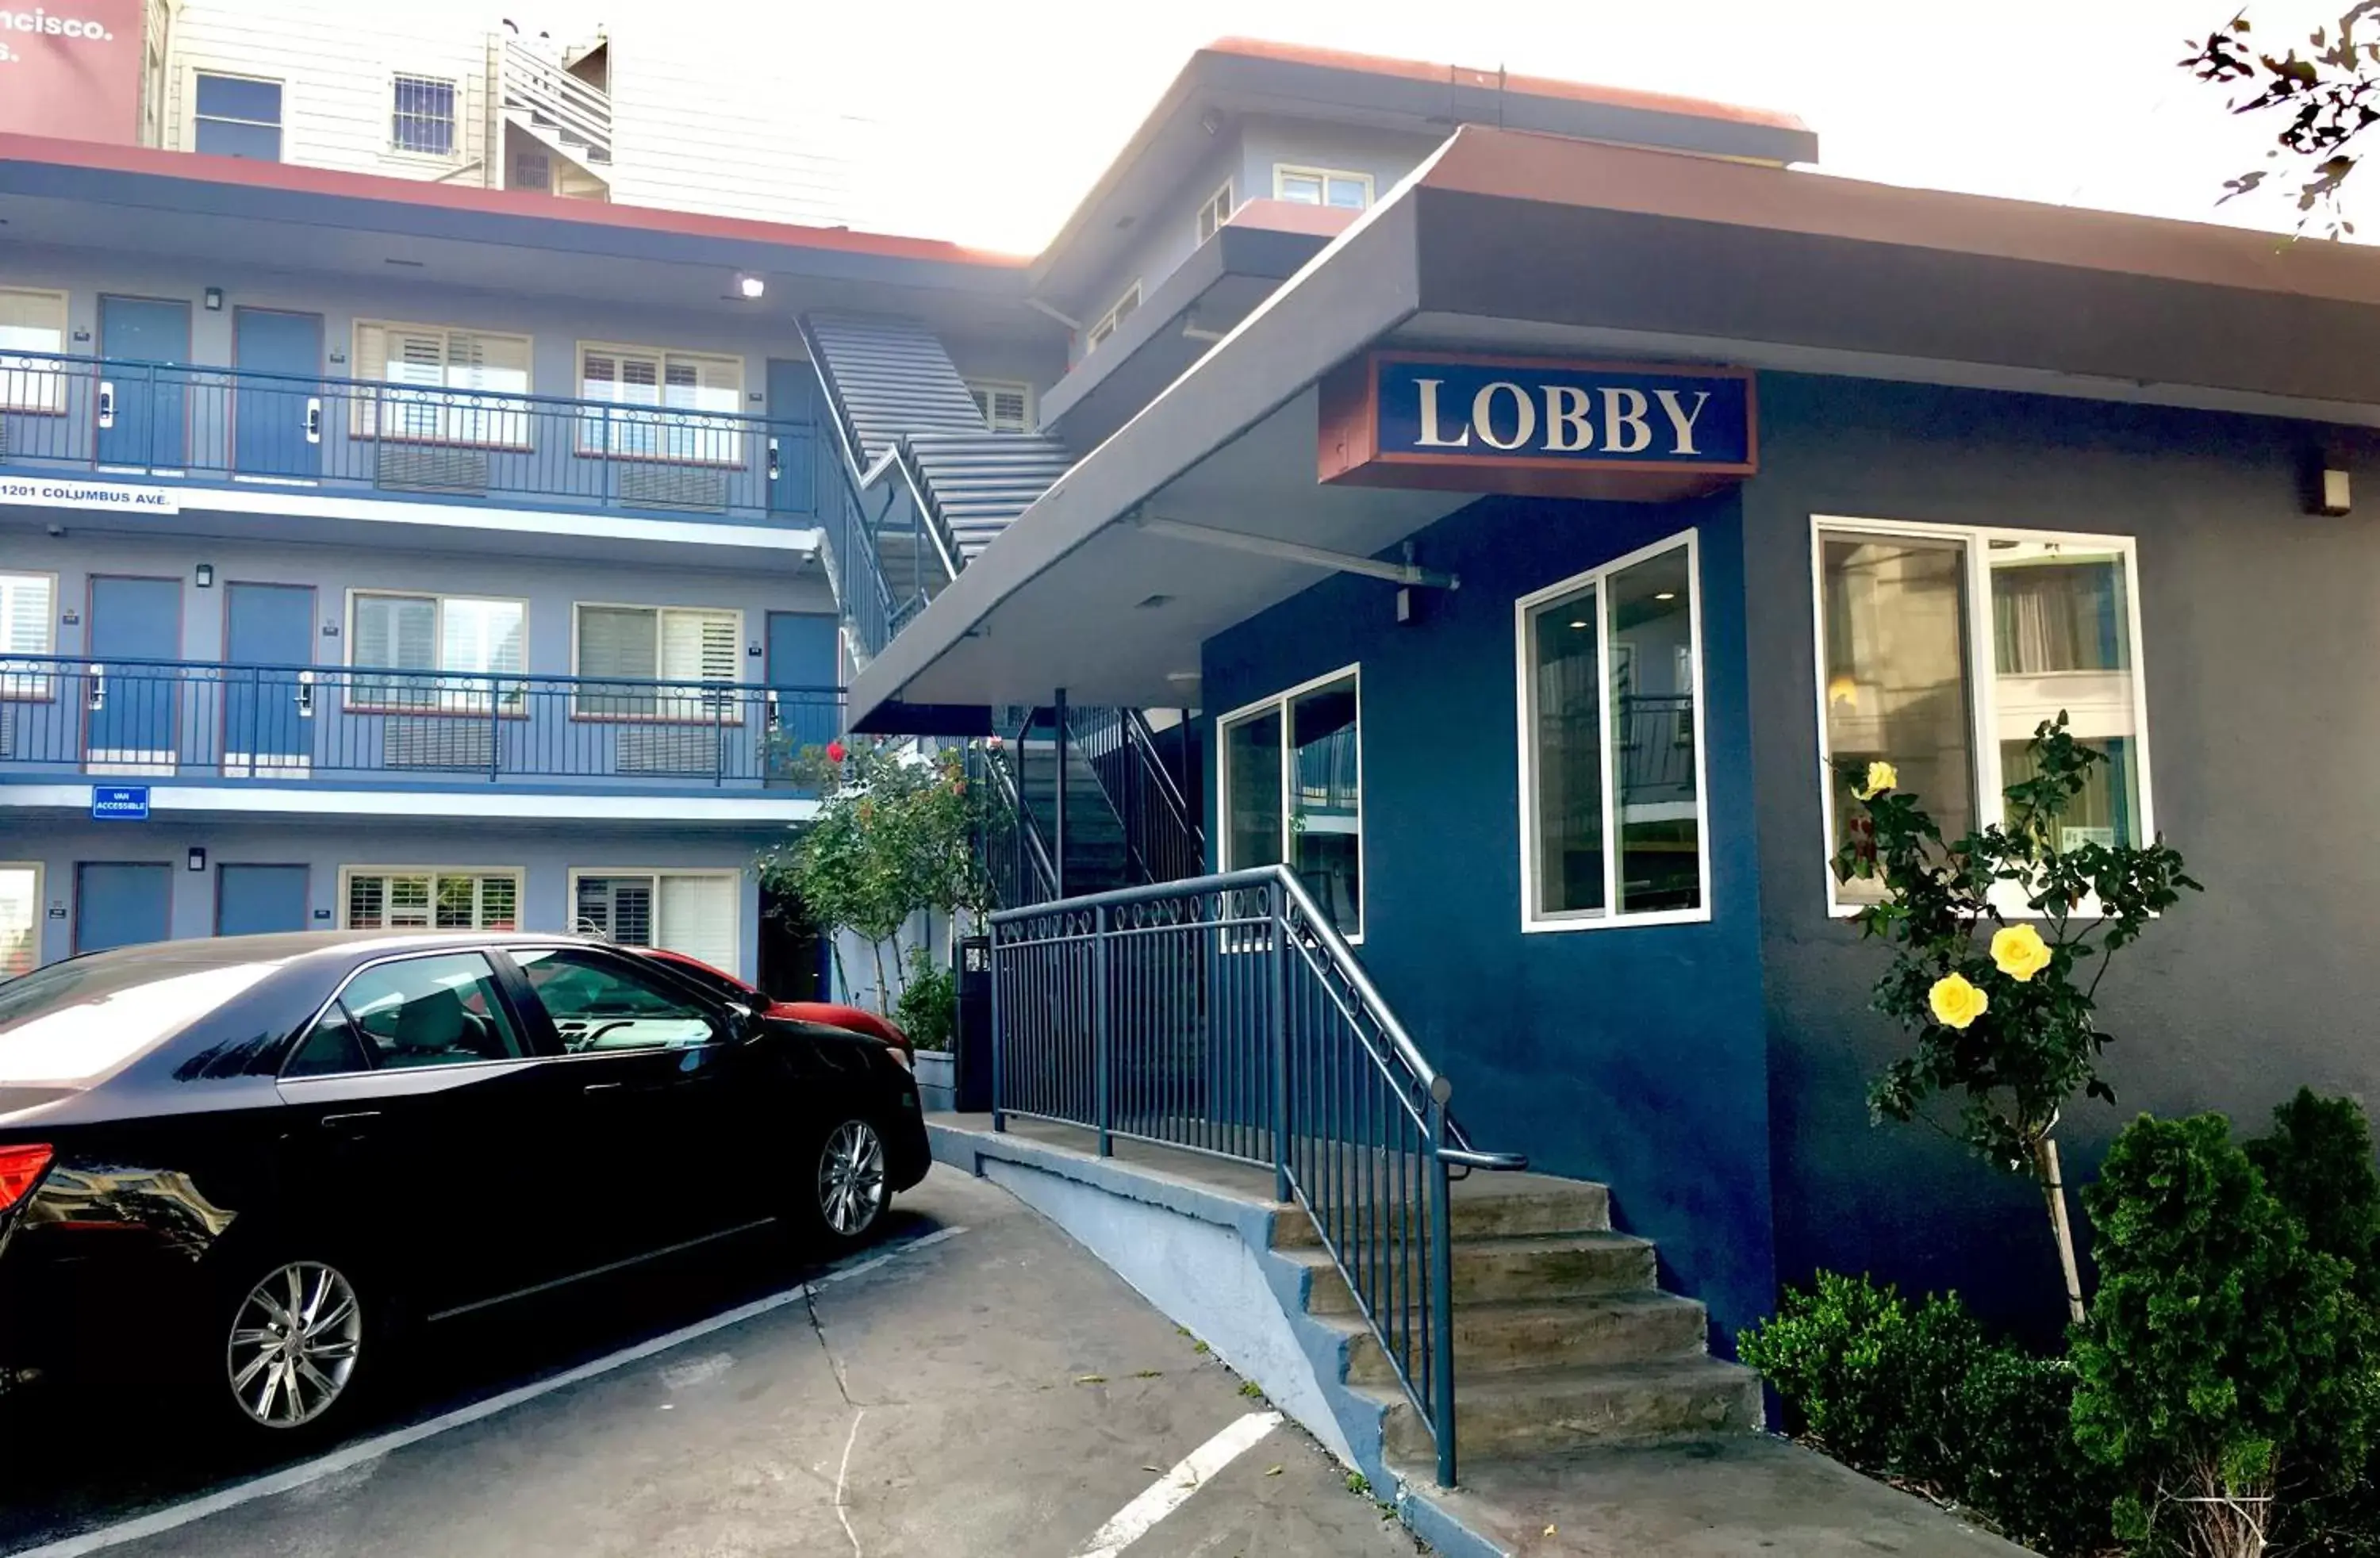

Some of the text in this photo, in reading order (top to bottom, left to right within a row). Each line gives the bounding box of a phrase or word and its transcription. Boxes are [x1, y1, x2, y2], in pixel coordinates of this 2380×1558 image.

[1412, 378, 1710, 455] LOBBY
[1, 485, 171, 506] 1201 COLUMBUS AVE.
